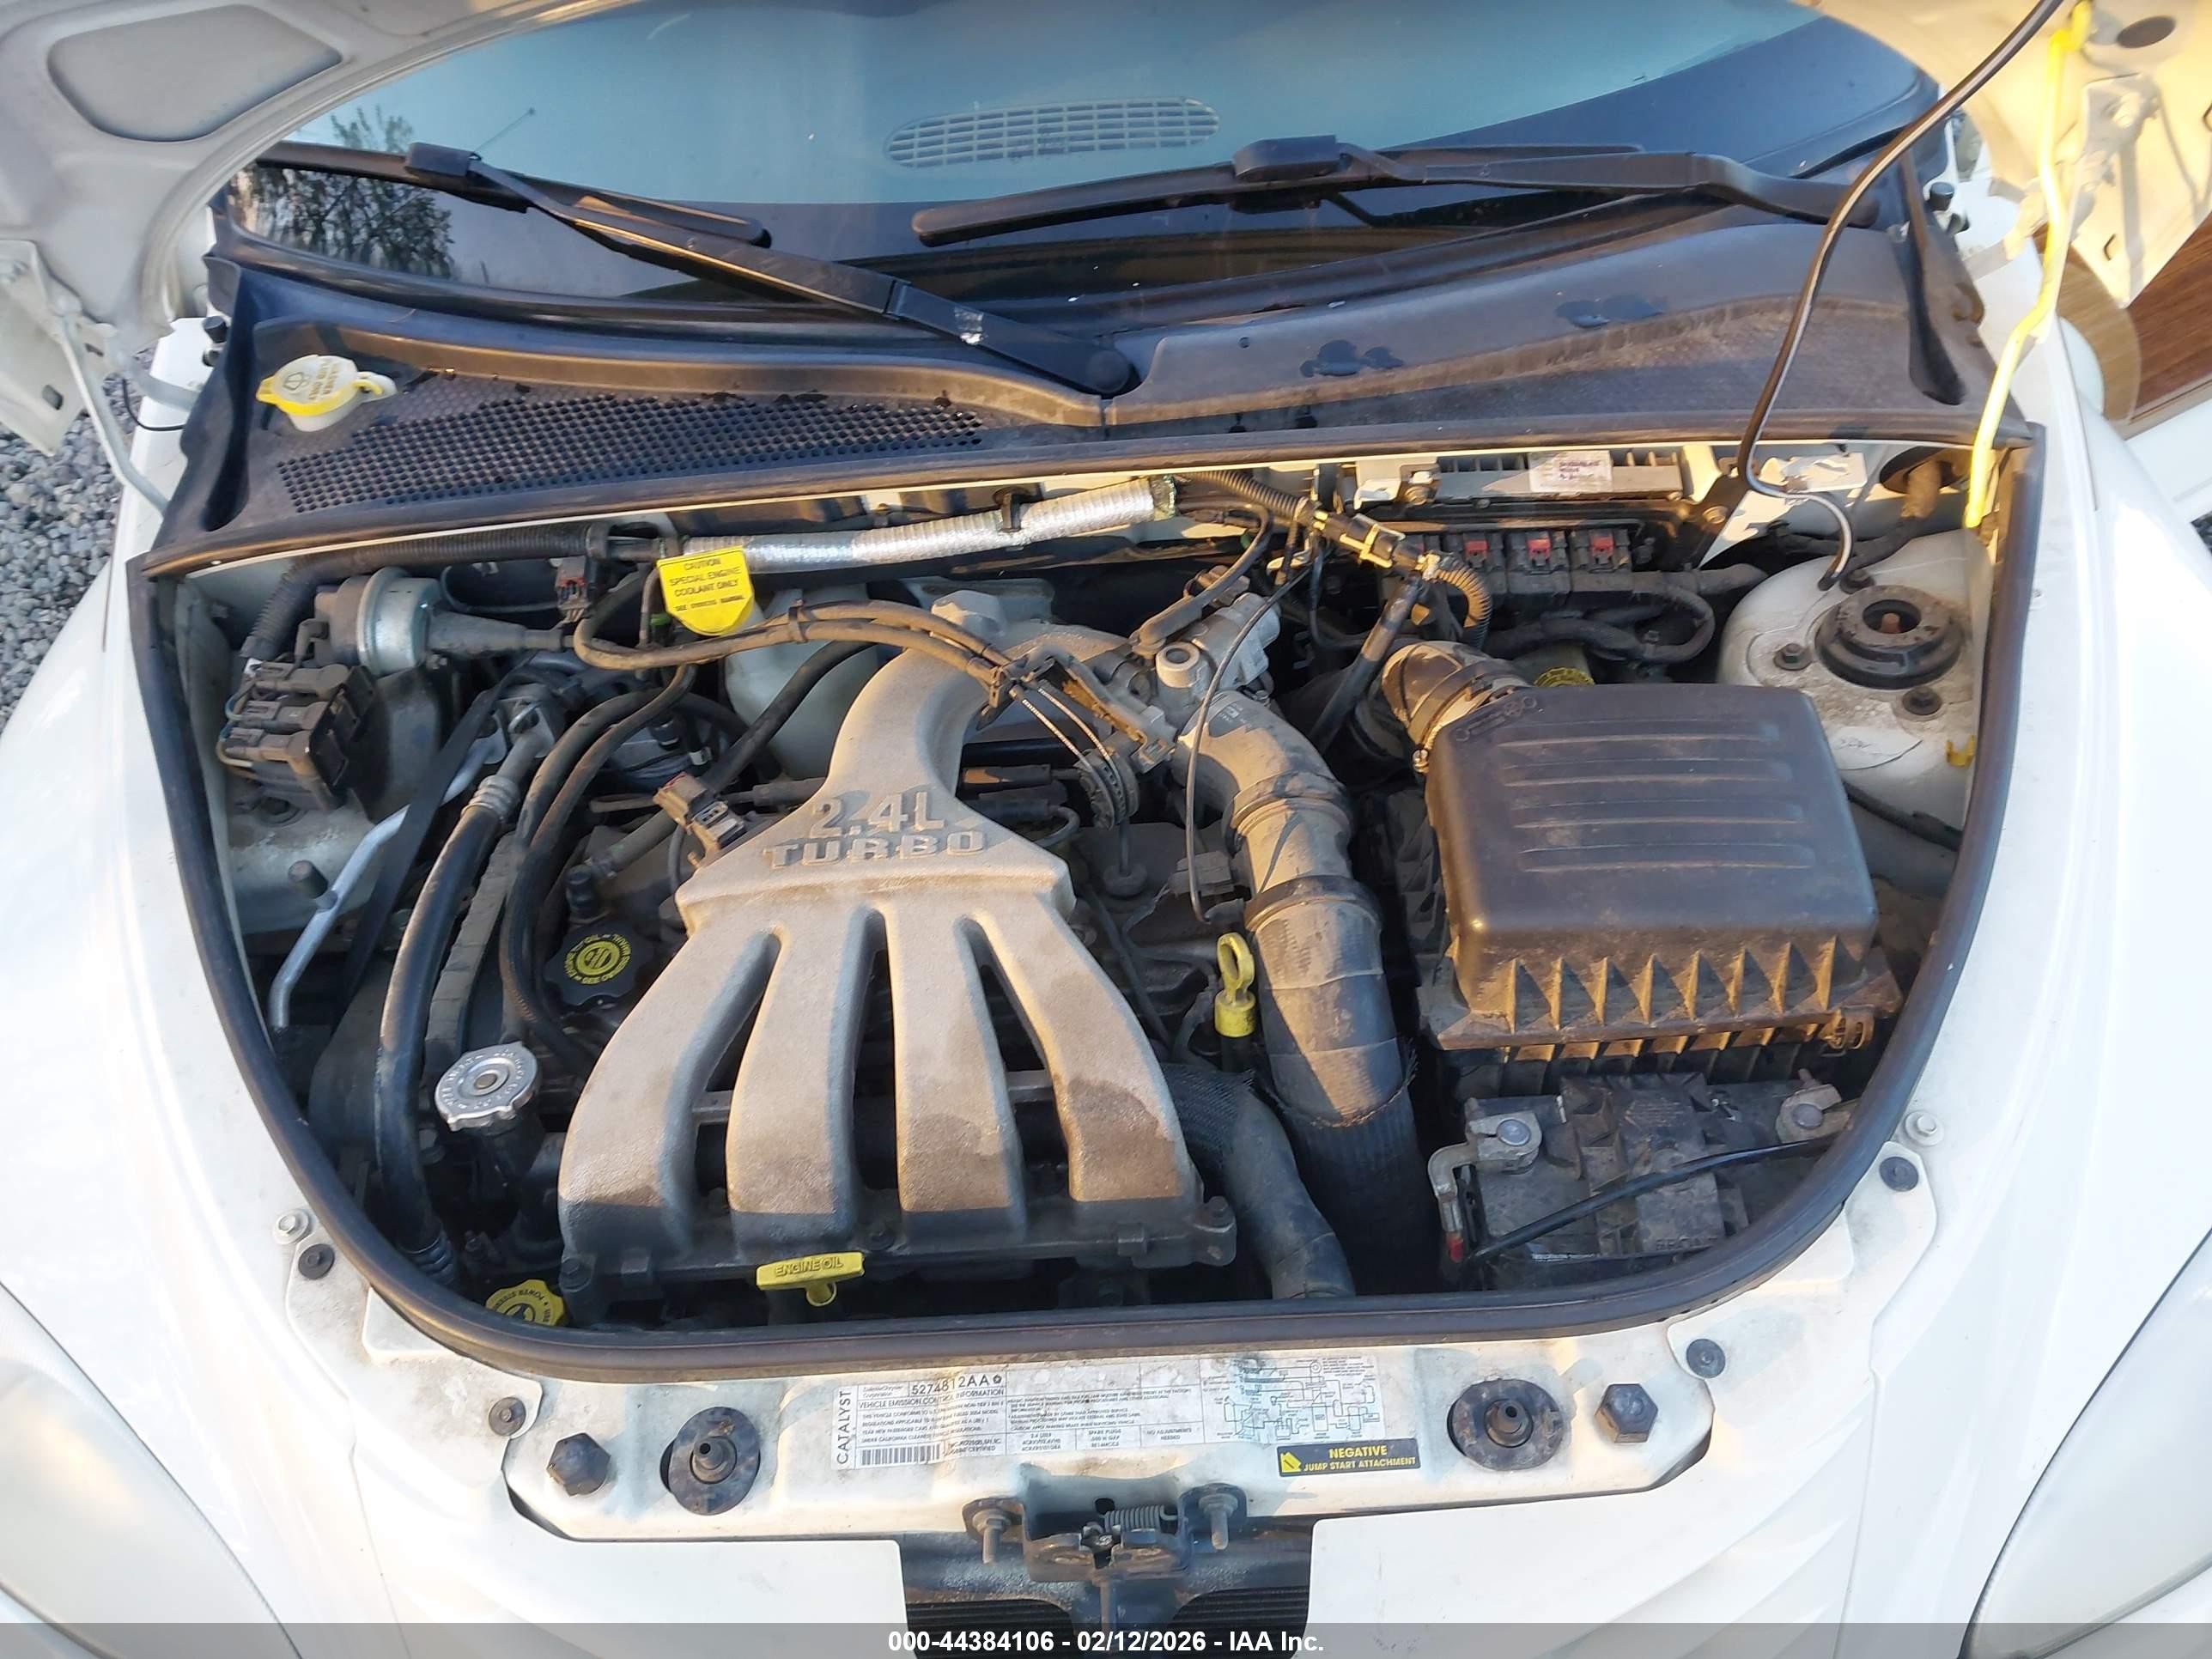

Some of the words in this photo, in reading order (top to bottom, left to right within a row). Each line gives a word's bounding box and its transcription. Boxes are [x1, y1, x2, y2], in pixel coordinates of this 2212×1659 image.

[684, 558, 721, 570] CAUTION
[670, 574, 706, 586] SPECIAL
[707, 566, 742, 580] ENGINE
[674, 583, 714, 597] COOLANT
[716, 579, 739, 590] ONLY
[810, 791, 945, 839] 2.4L
[764, 831, 986, 868] TURBO
[775, 1258, 821, 1277] ENGINE
[822, 1256, 844, 1270] OIL
[860, 1401, 886, 1409] VEHICLE
[889, 1399, 921, 1407] EMISSION
[956, 1389, 1004, 1399] INFORMATION
[836, 1390, 852, 1464] CATALYST
[1329, 1445, 1388, 1458] NEGATIVE
[1304, 1462, 1328, 1472] JUMP
[1329, 1461, 1356, 1470] START
[1358, 1457, 1416, 1468] ATTACHMENT
